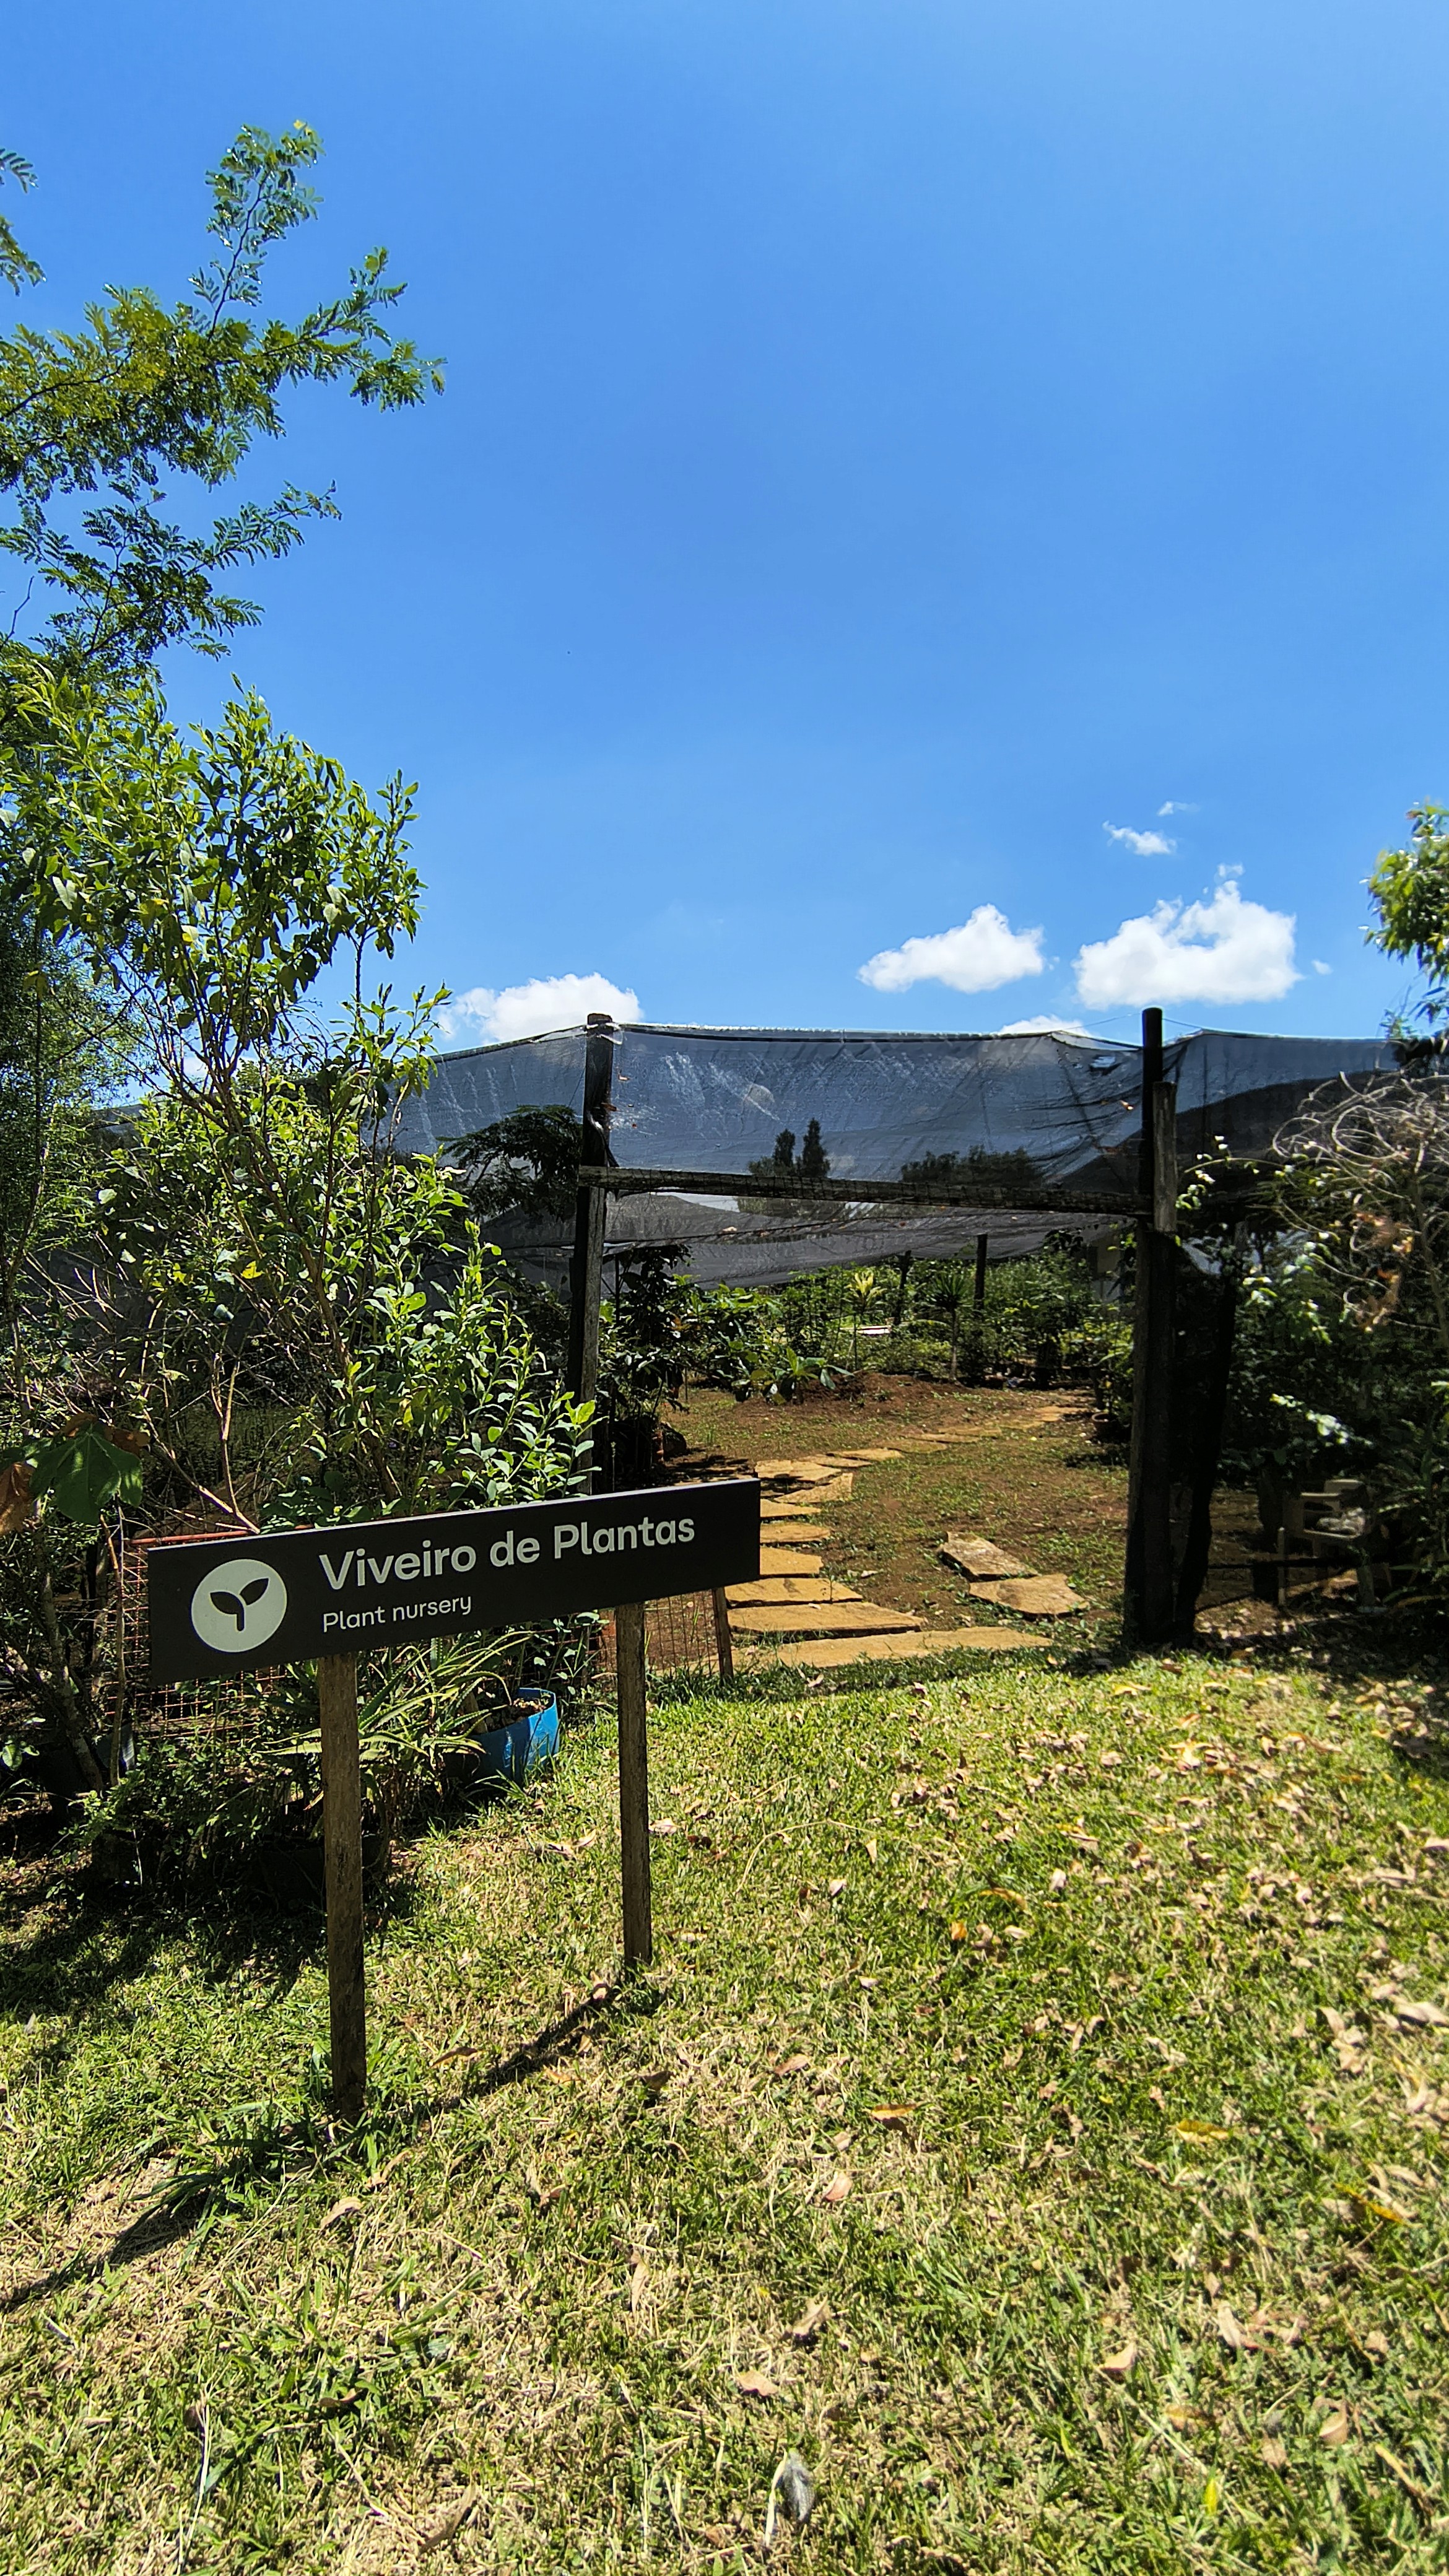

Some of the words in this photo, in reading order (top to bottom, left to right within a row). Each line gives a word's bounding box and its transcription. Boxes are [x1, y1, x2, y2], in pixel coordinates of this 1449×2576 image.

[318, 1539, 477, 1590] Viveiro
[489, 1530, 540, 1567] de
[554, 1516, 695, 1559] Plantas
[323, 1606, 385, 1633] Plant
[392, 1595, 472, 1621] nursery
